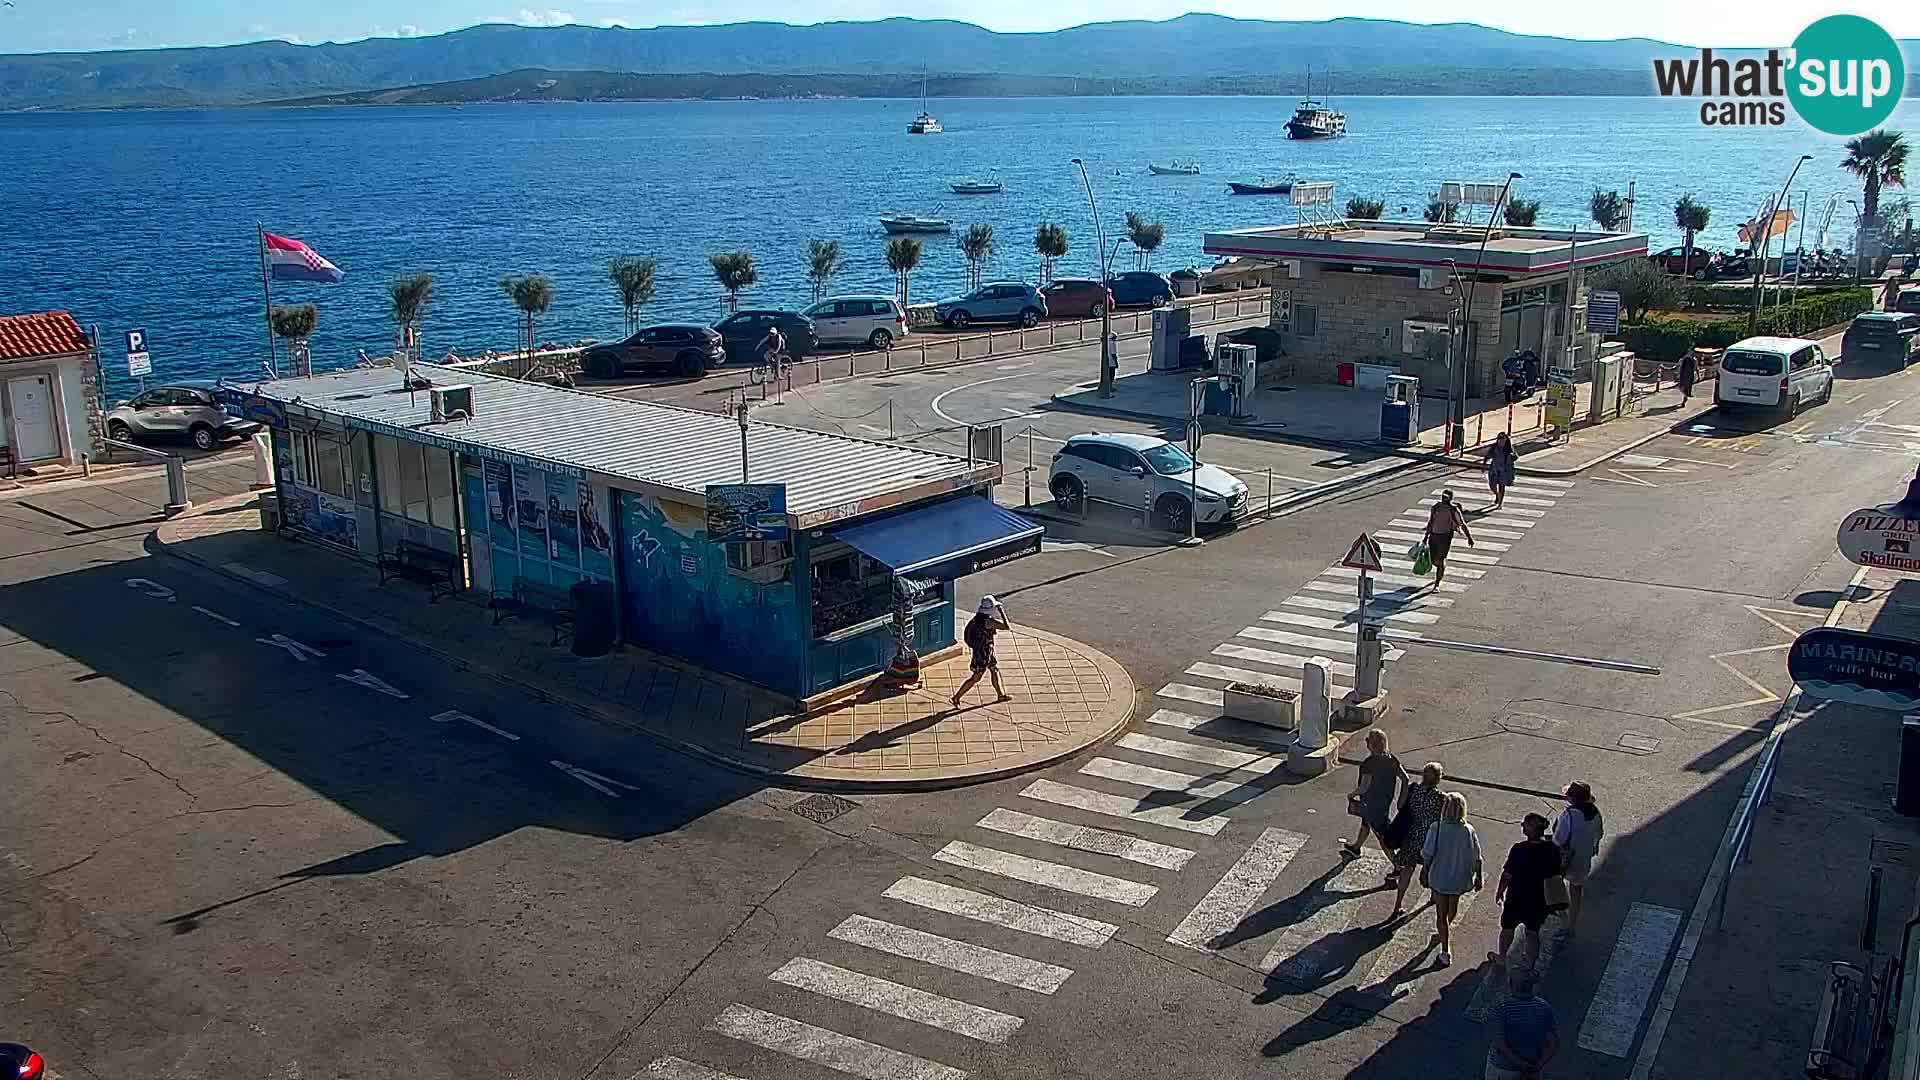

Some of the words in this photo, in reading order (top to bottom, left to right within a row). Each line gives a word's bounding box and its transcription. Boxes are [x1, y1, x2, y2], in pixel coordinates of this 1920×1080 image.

[129, 332, 143, 350] P
[478, 447, 493, 458] BUS
[493, 450, 526, 465] STATION
[527, 458, 554, 472] TICKET
[555, 463, 583, 478] OFFICE
[1848, 516, 1920, 536] PIZZE
[1800, 643, 1920, 674] MARINER
[1870, 666, 1897, 681] bar
